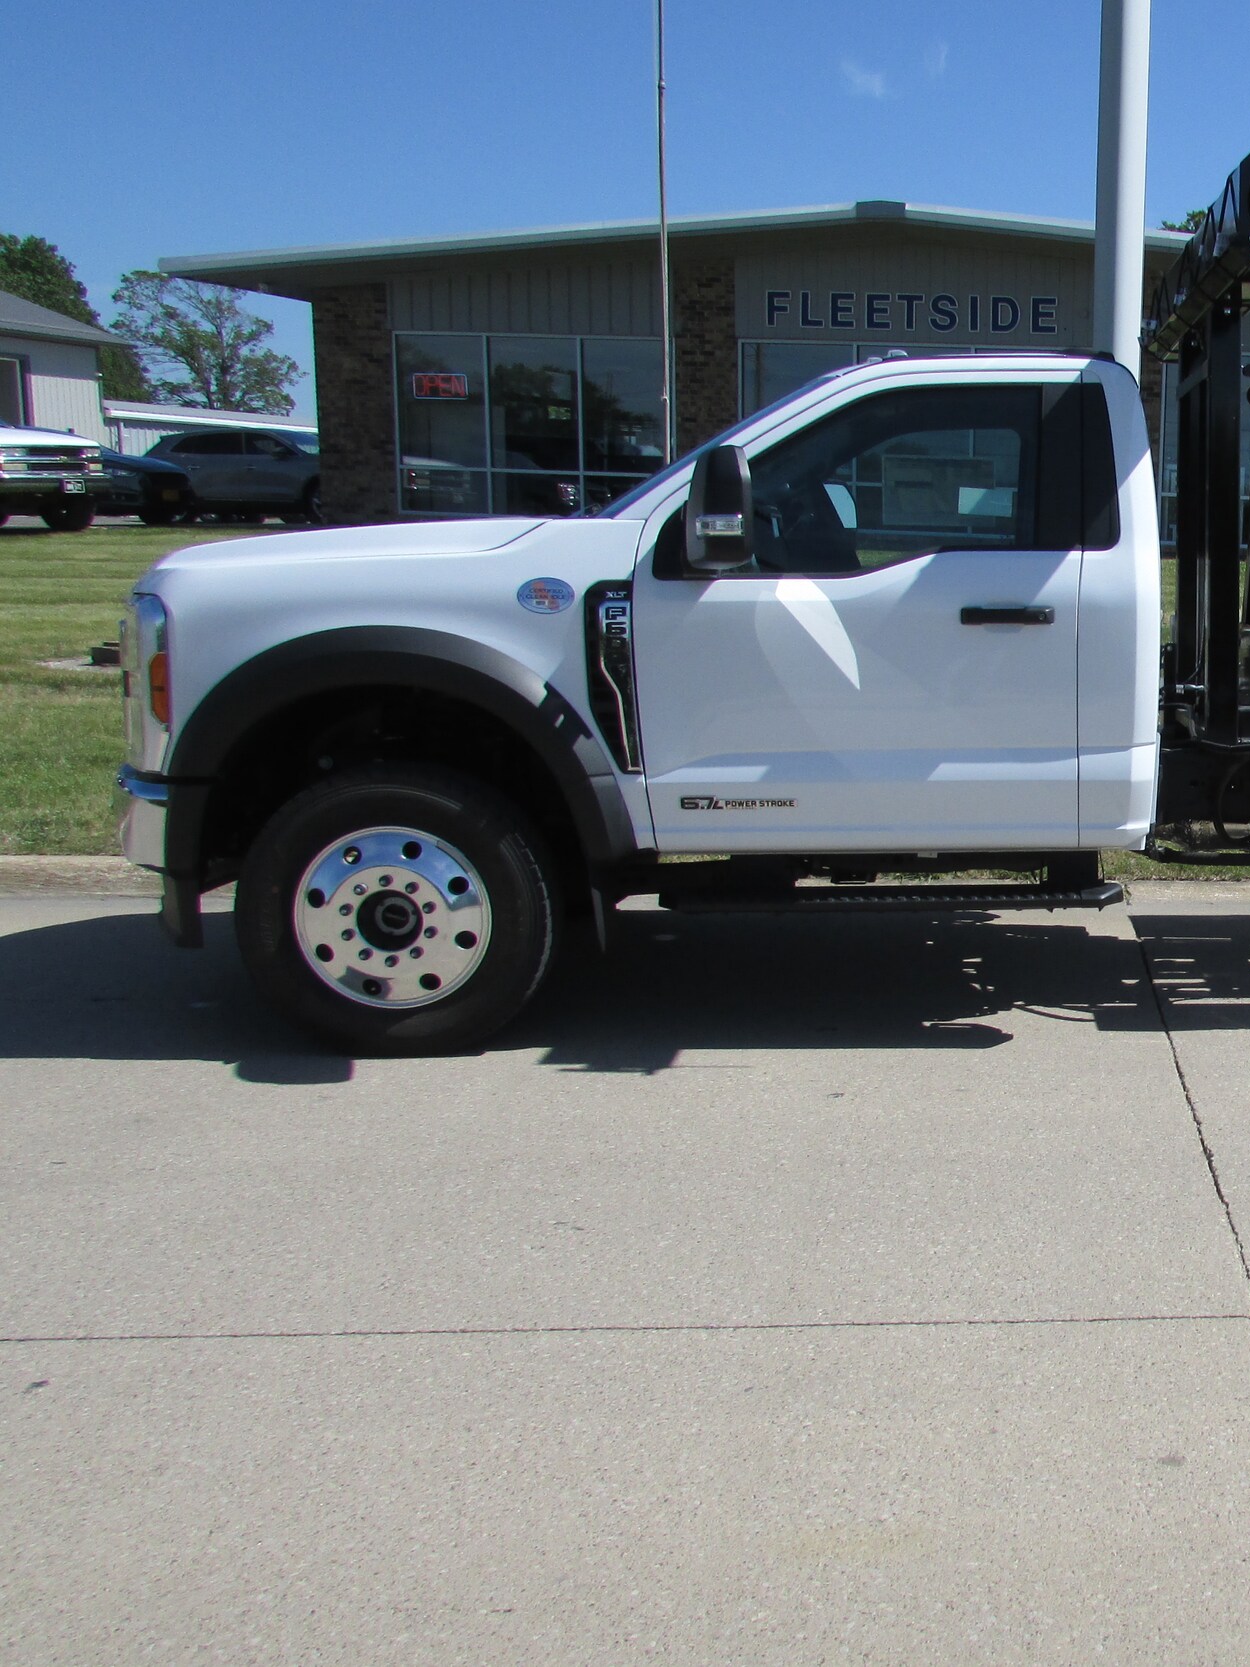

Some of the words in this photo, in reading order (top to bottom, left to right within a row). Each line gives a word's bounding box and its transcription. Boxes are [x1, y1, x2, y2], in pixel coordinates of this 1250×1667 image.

[765, 290, 1058, 335] FLEETSIDE
[415, 375, 465, 397] OPEN
[680, 796, 724, 810] 6.7L
